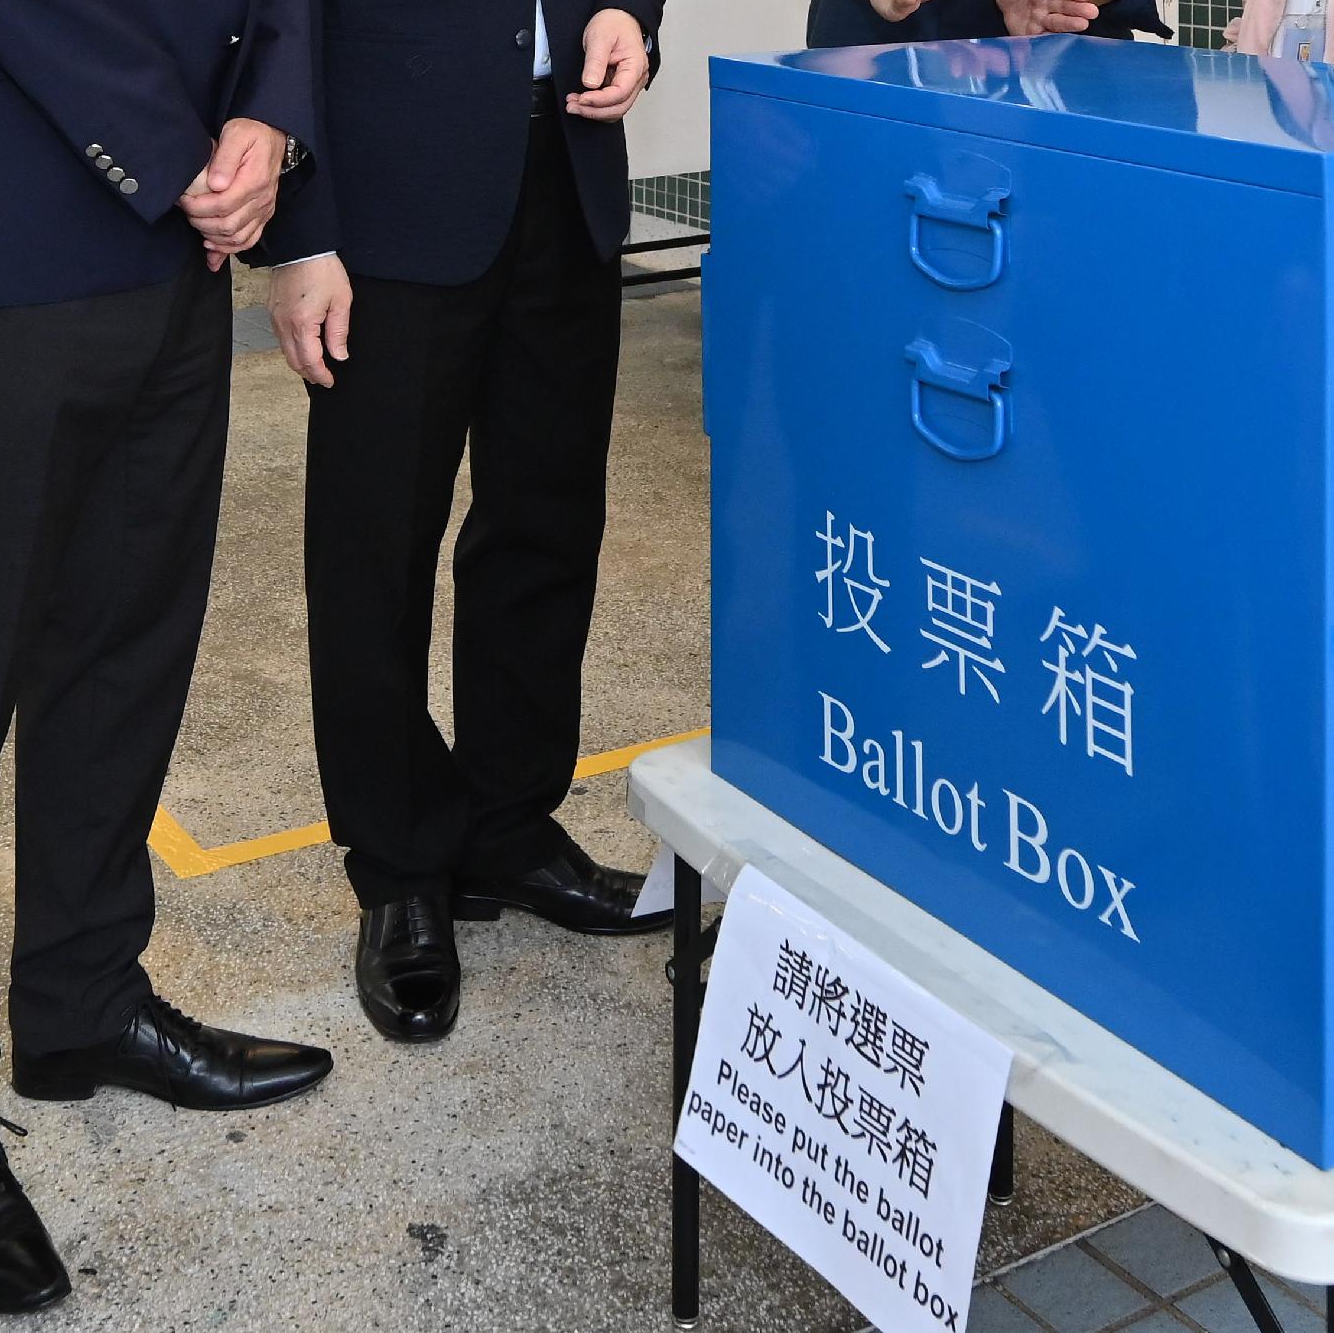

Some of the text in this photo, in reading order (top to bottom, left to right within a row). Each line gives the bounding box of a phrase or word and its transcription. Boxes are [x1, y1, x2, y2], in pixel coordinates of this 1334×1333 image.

[814, 509, 1138, 778] 投票箱
[817, 689, 1141, 944] Ballot Box
[740, 1001, 938, 1200] 放入投票箱
[772, 938, 931, 1098] 請將選票
[687, 1090, 960, 1333] paper into the ballot box
[717, 1058, 945, 1269] Please put the ballot
